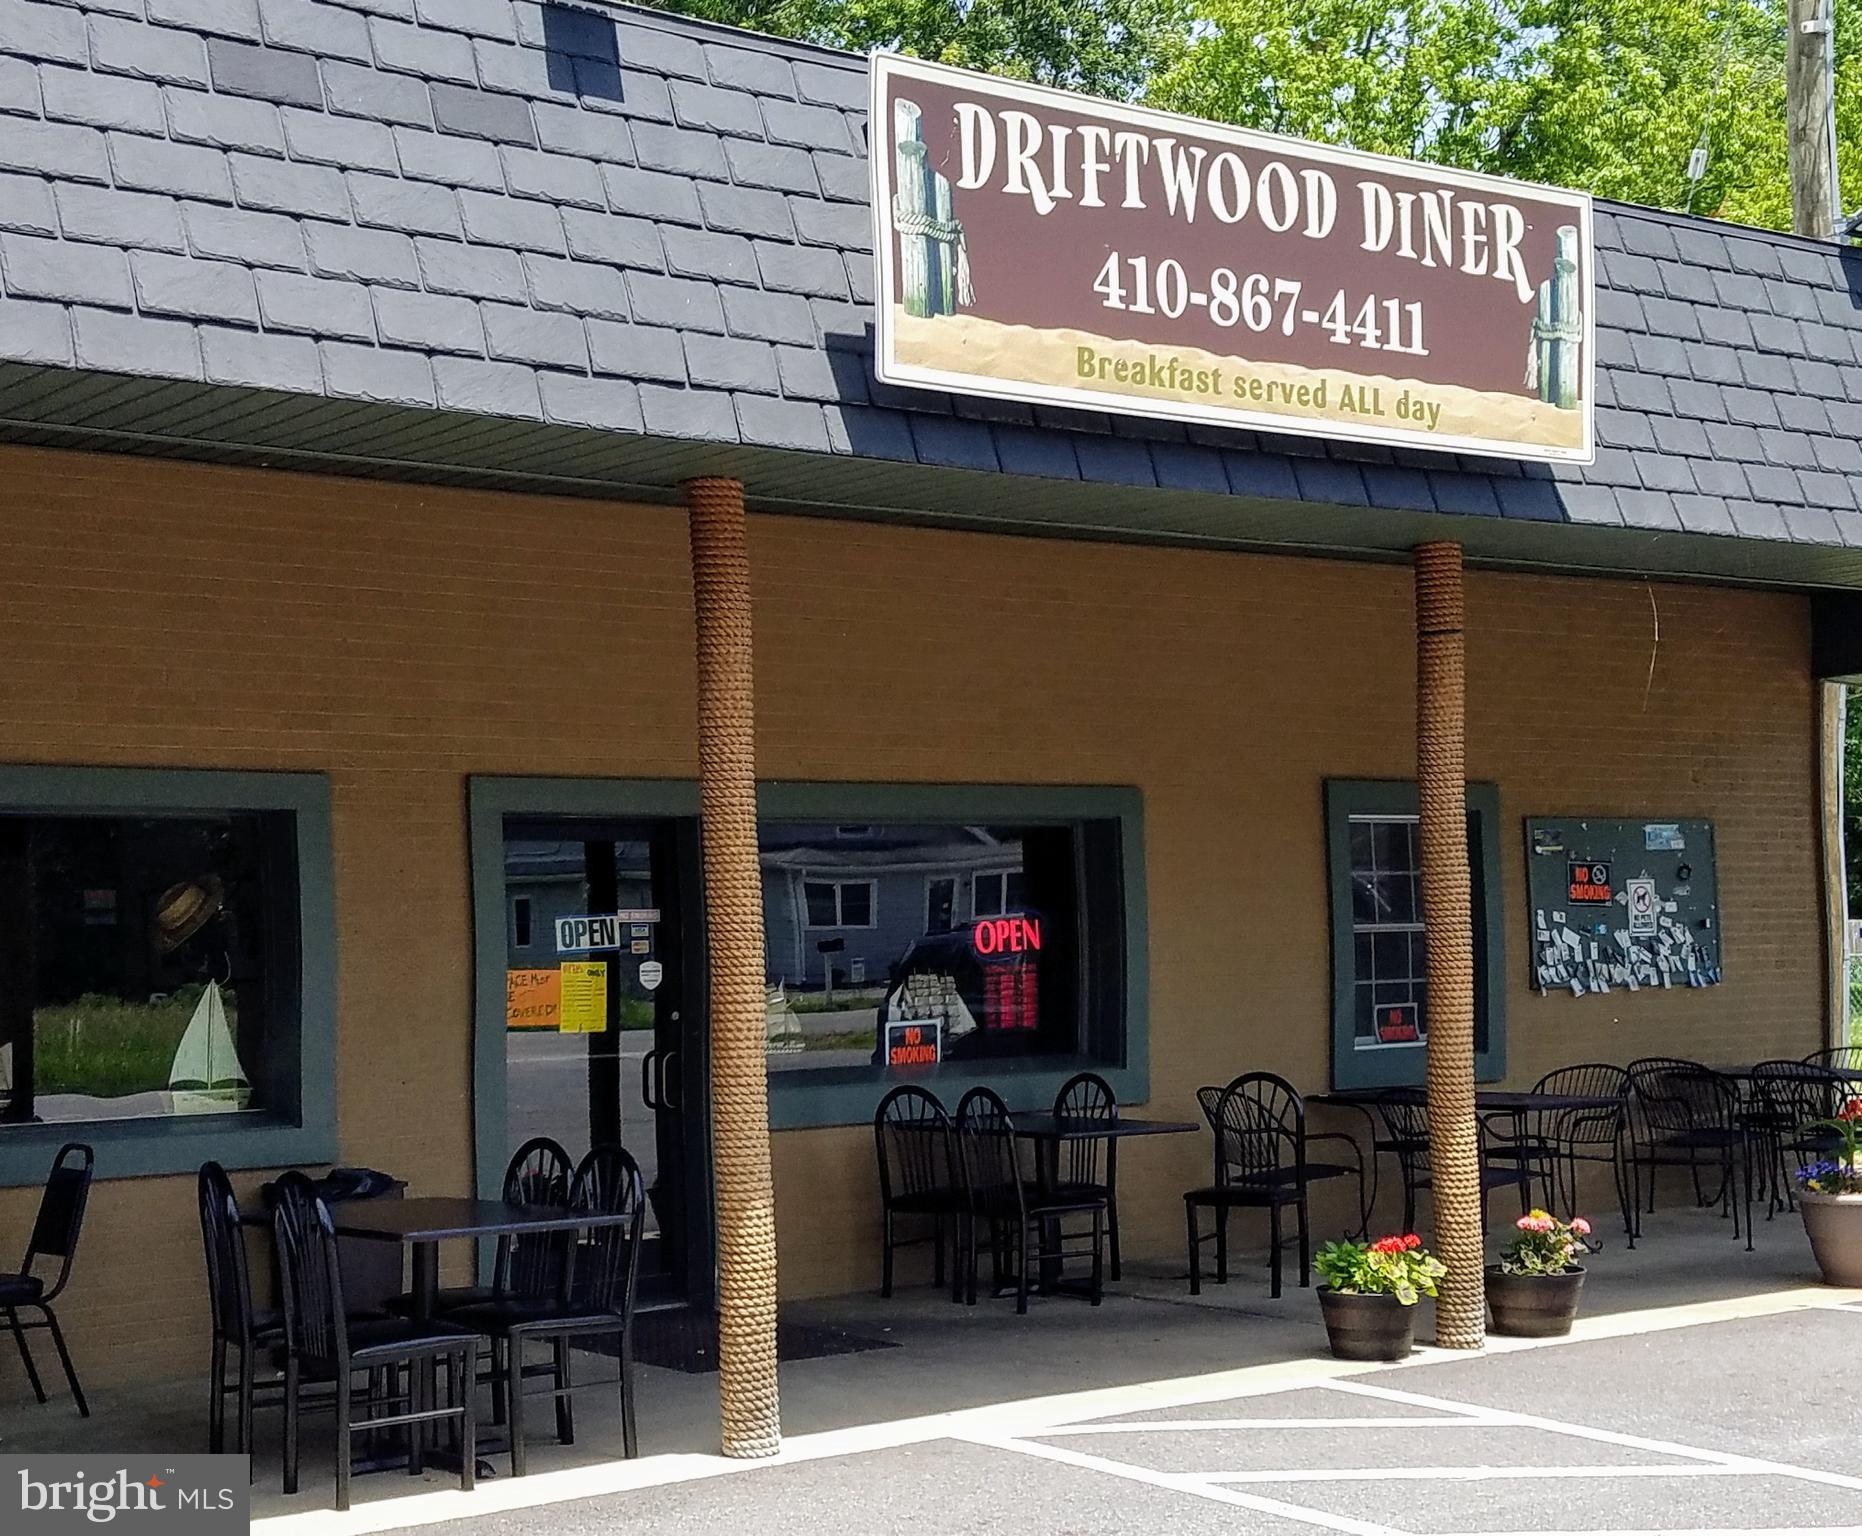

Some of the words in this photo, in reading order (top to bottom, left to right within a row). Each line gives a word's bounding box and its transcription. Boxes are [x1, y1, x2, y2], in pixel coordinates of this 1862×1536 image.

[953, 102, 1338, 239] DRIFTWOOD
[1356, 181, 1536, 304] DINER
[1093, 251, 1430, 356] 410-867-4411
[1076, 346, 1222, 395] Breakfast
[1233, 376, 1327, 409] served
[1339, 384, 1385, 416] ALL
[1396, 390, 1441, 430] day
[1575, 867, 1588, 882] NO
[1570, 884, 1611, 900] SMOKING
[561, 918, 615, 948] OPEN
[975, 919, 1040, 953] OPEN
[905, 1027, 921, 1045] NO
[891, 1044, 936, 1064] SMOKING
